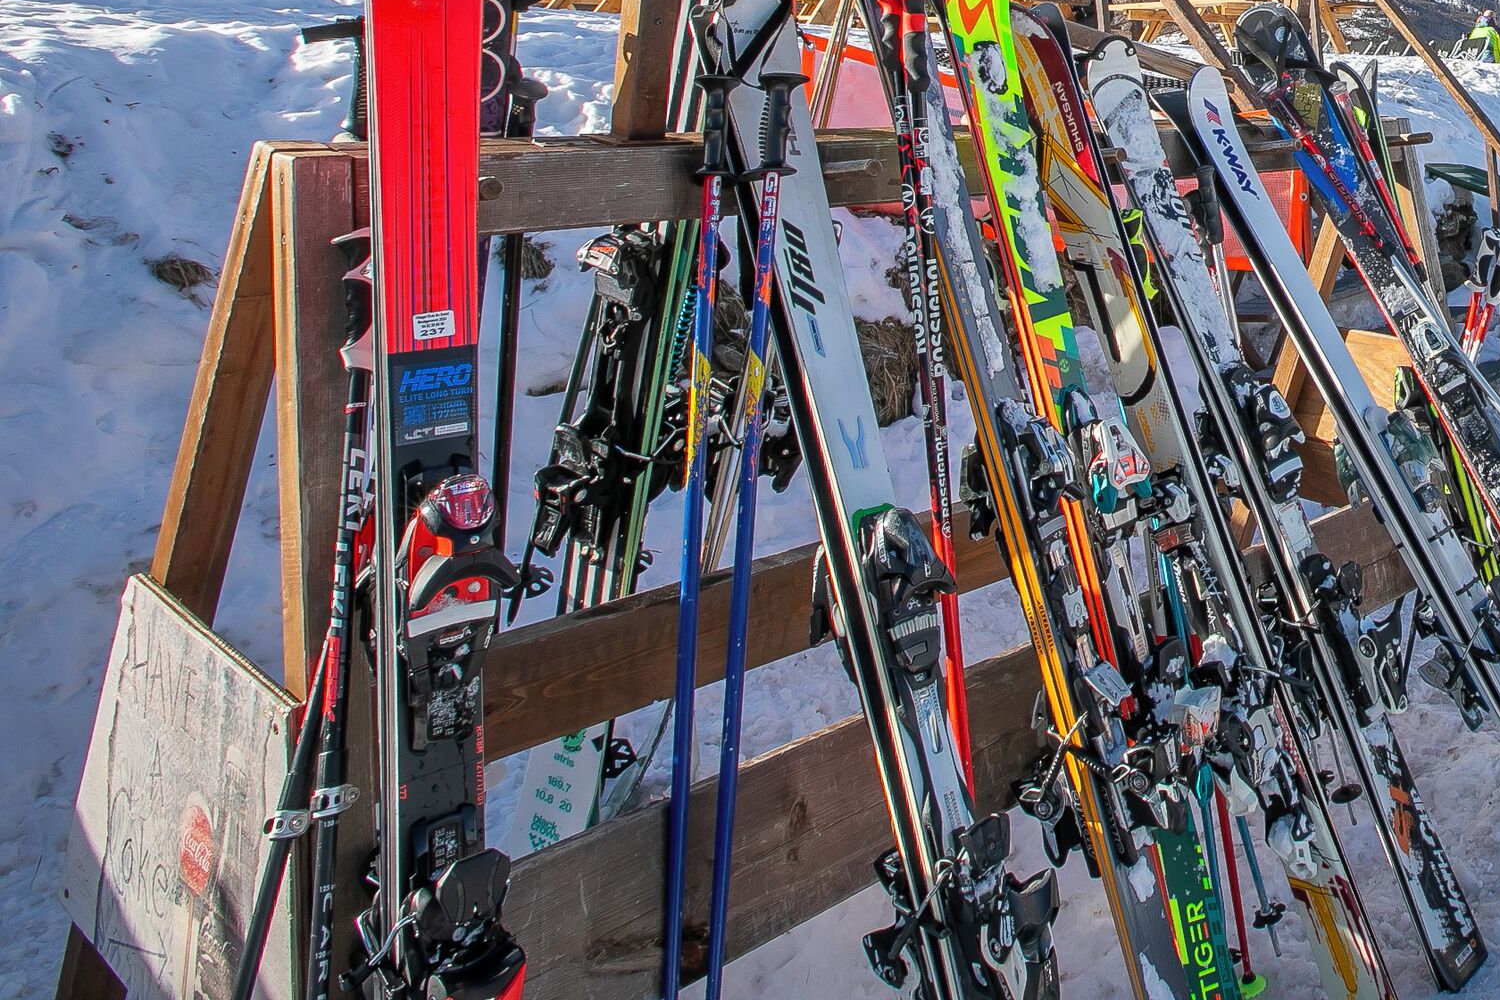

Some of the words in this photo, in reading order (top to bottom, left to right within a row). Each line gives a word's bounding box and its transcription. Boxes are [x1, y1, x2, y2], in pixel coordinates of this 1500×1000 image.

[1055, 81, 1084, 152] SHUKSAN
[1212, 129, 1260, 200] K-WAY
[1327, 170, 1368, 223] GIPRON
[420, 327, 446, 337] 237
[399, 363, 473, 393] HERO
[399, 393, 424, 404] ELITE
[425, 390, 449, 400] LONG
[451, 386, 474, 396] TURN
[345, 447, 368, 532] LEKI
[553, 751, 575, 768] atris
[548, 775, 572, 793] 189.7
[535, 788, 555, 805] 10.8
[559, 800, 573, 813] 20
[323, 819, 335, 827] 130
[533, 812, 558, 831] black
[530, 823, 560, 842] crows
[319, 884, 331, 893] 125
[315, 950, 327, 959] 120
[316, 891, 334, 1000] CAR
[1185, 899, 1222, 1000] TIGER
